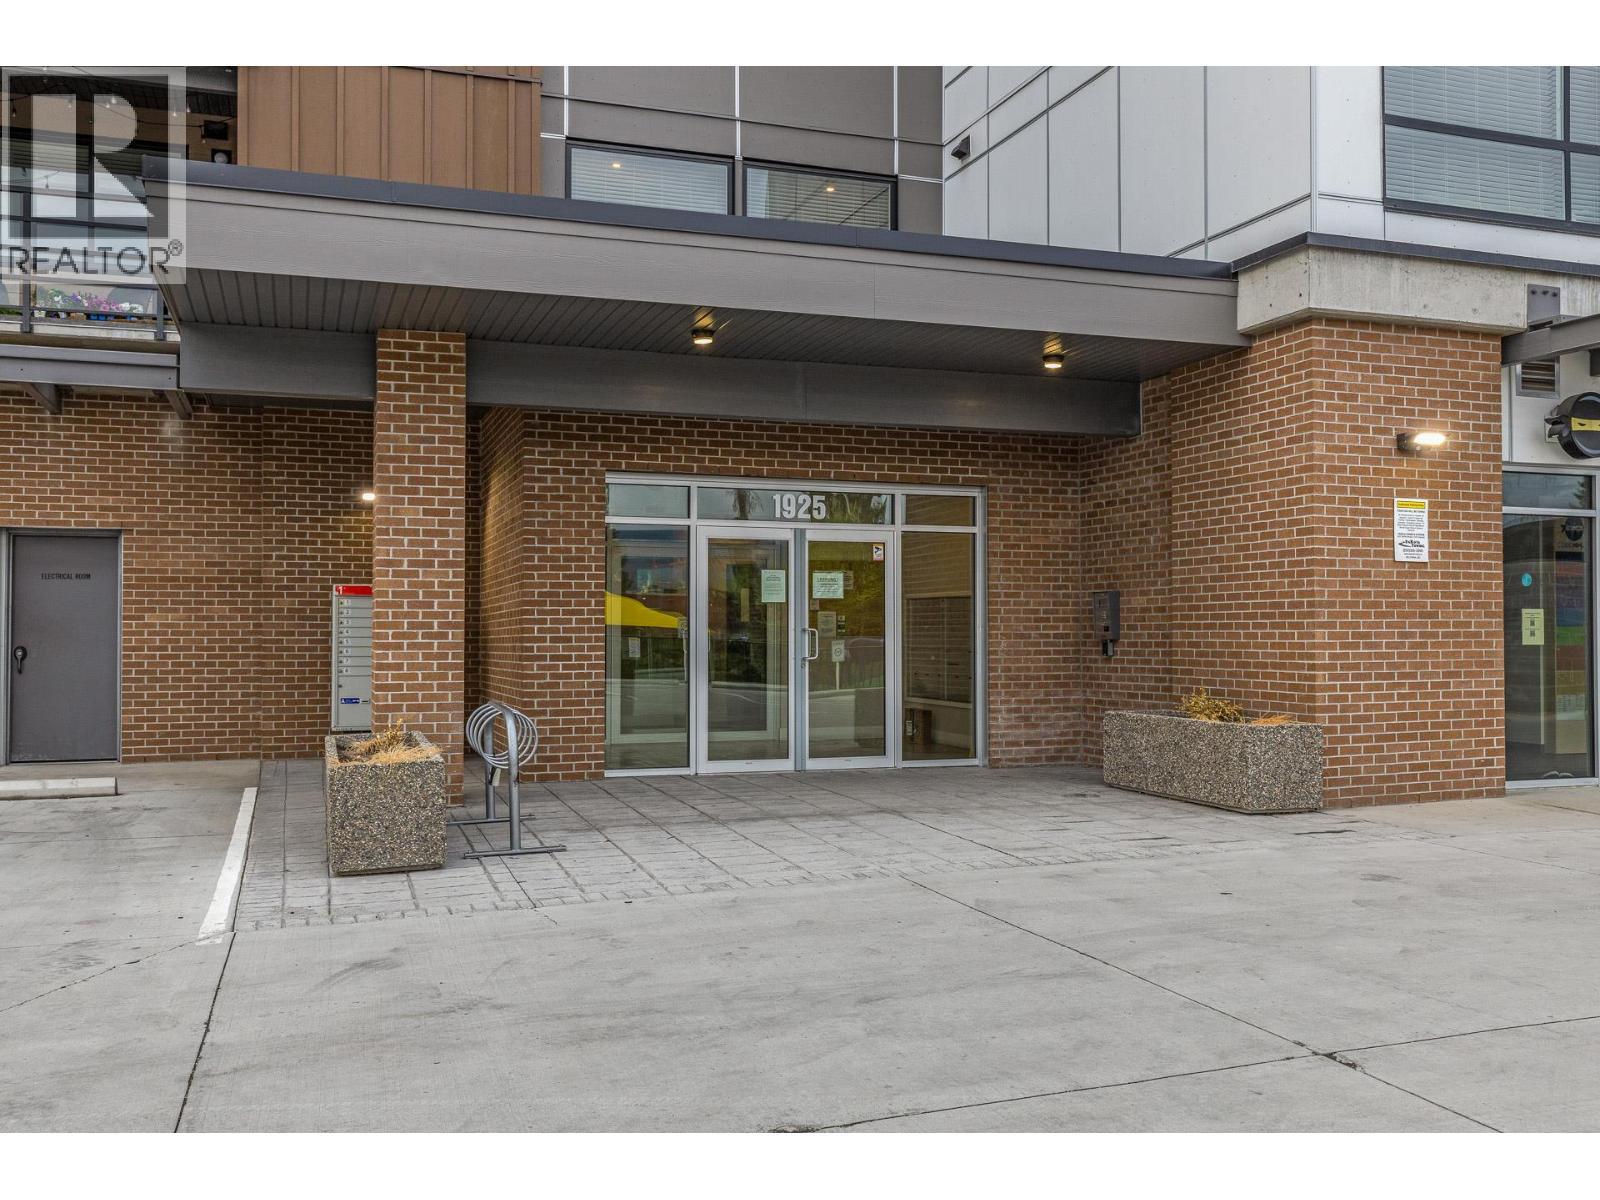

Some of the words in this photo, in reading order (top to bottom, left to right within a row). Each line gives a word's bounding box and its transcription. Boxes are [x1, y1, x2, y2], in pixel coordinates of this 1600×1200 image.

[772, 493, 827, 520] 1925
[41, 572, 73, 580] ELECTRICAL
[75, 572, 91, 580] ROOM
